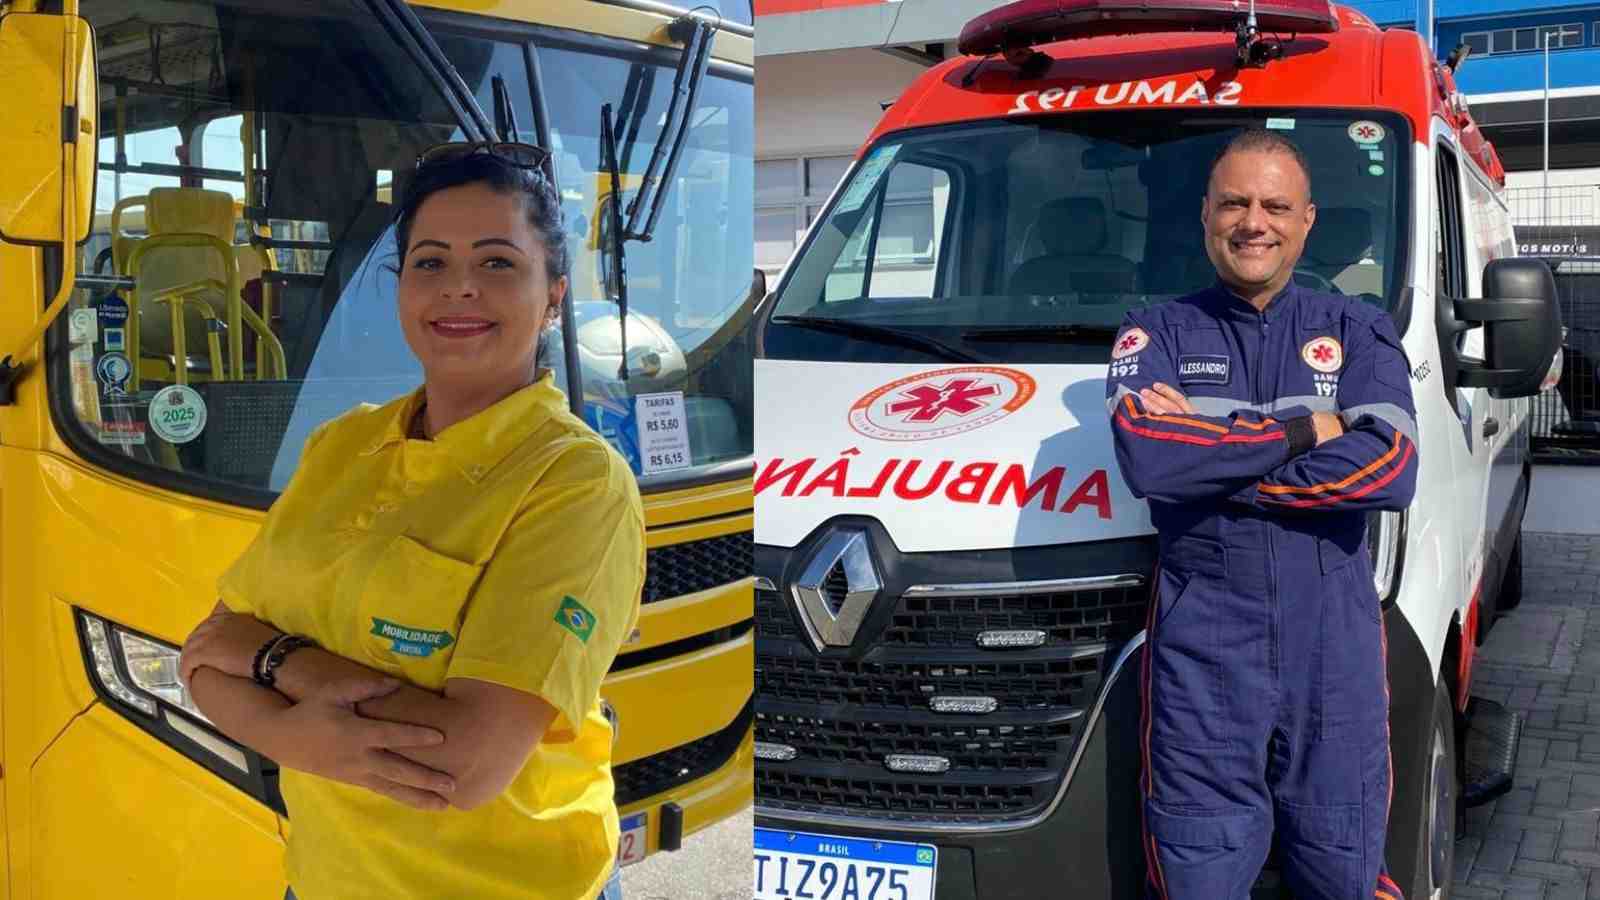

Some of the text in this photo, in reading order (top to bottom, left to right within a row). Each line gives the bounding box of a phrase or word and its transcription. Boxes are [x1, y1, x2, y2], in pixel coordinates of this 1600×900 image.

[1516, 244, 1538, 253] OS
[1111, 364, 1139, 377] 192
[1179, 360, 1226, 376] ALESSANDRO
[645, 398, 675, 407] TARIFAS
[163, 407, 195, 423] 2025
[646, 420, 658, 432] R$
[650, 455, 662, 466] R$
[382, 623, 441, 644] MOBILIDADE
[818, 843, 849, 856] BRASIL
[754, 855, 909, 900] TIZ9A75
